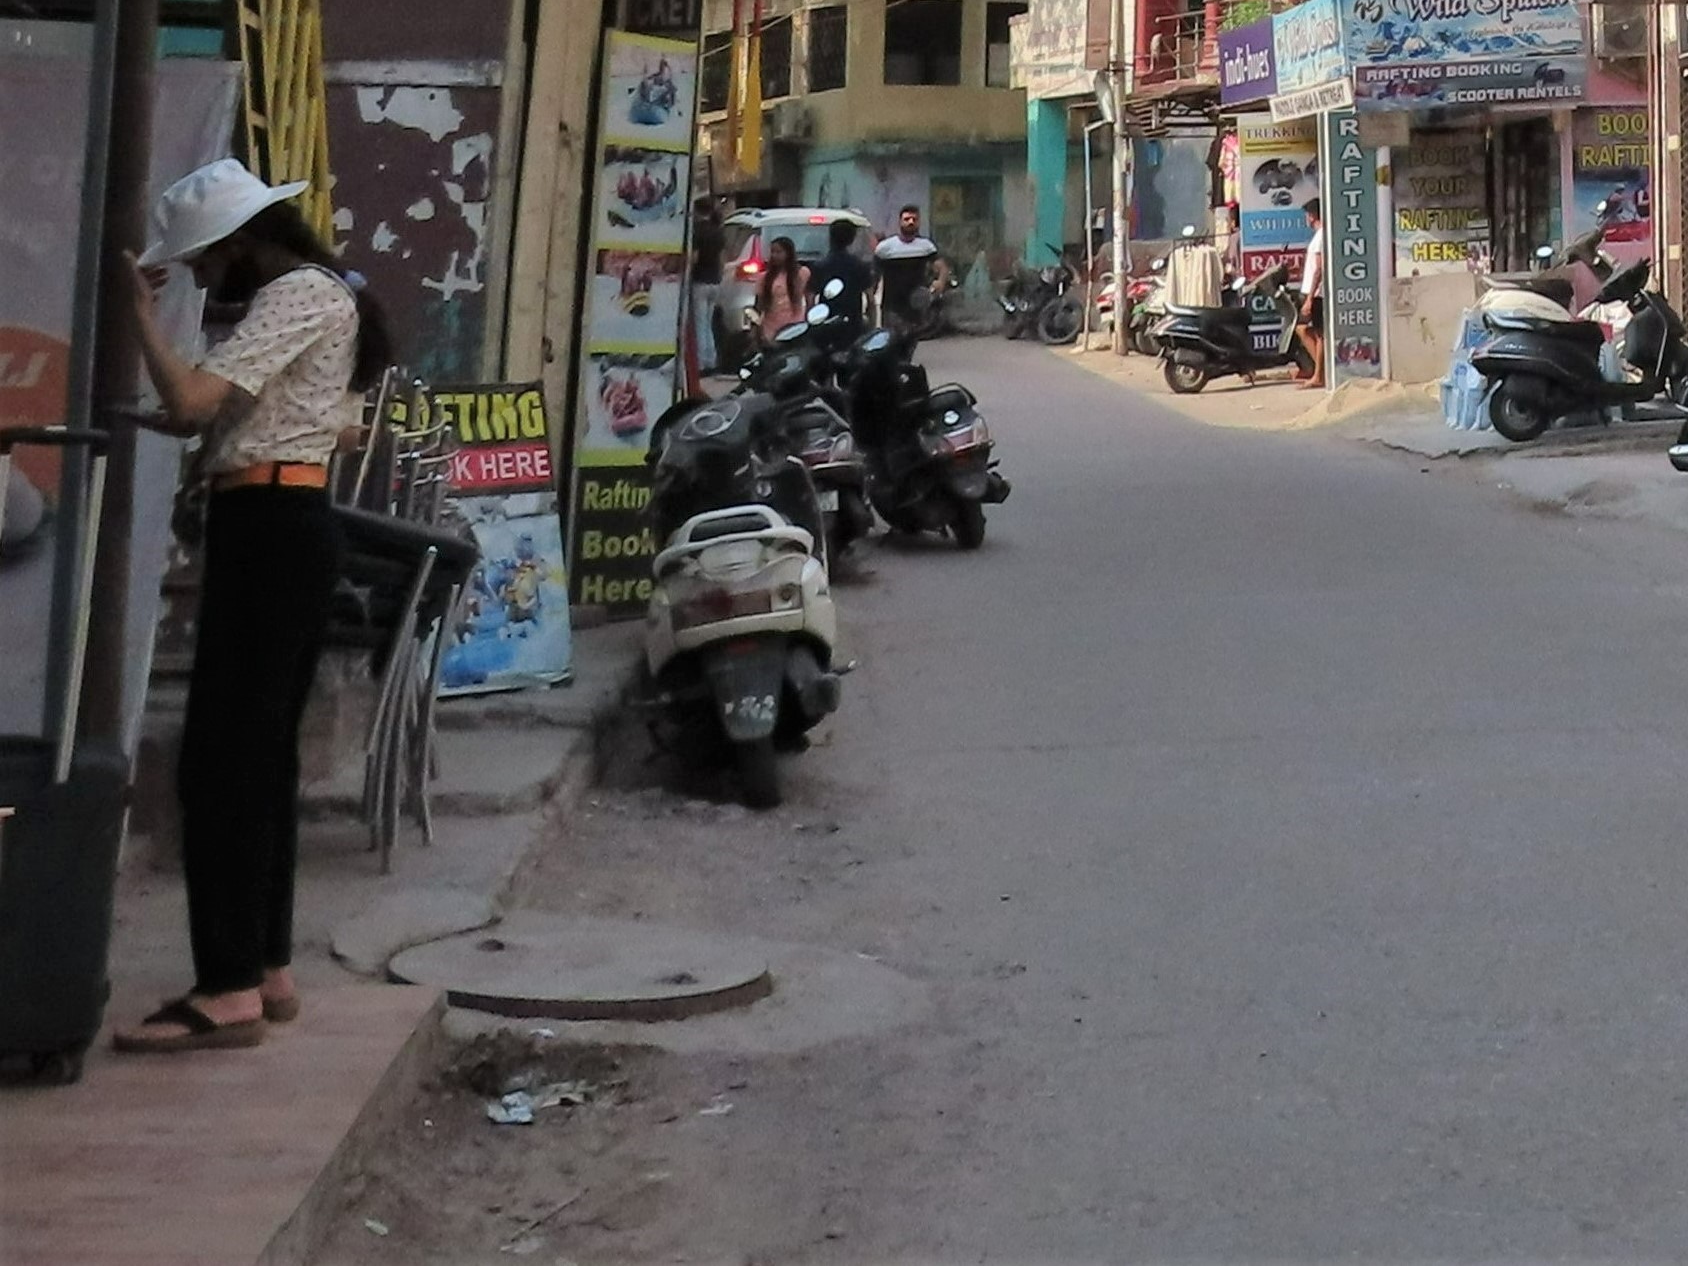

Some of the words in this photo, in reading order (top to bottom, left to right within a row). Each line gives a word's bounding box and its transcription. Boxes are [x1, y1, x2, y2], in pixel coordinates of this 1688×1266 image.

[1365, 65, 1442, 82] RAFTING
[1445, 62, 1524, 78] BOOKING
[1446, 87, 1514, 104] SCOOTER
[1597, 113, 1649, 135] BOO
[1581, 143, 1650, 168] RAFTI
[1338, 119, 1368, 280] RAFTING
[1412, 241, 1469, 262] HERE
[1250, 254, 1304, 272] RAFT
[1337, 287, 1373, 304] BOOK
[1338, 309, 1373, 325] HERE
[480, 449, 550, 481] HERE
[582, 482, 652, 512] Raftin
[582, 575, 652, 603] Here
